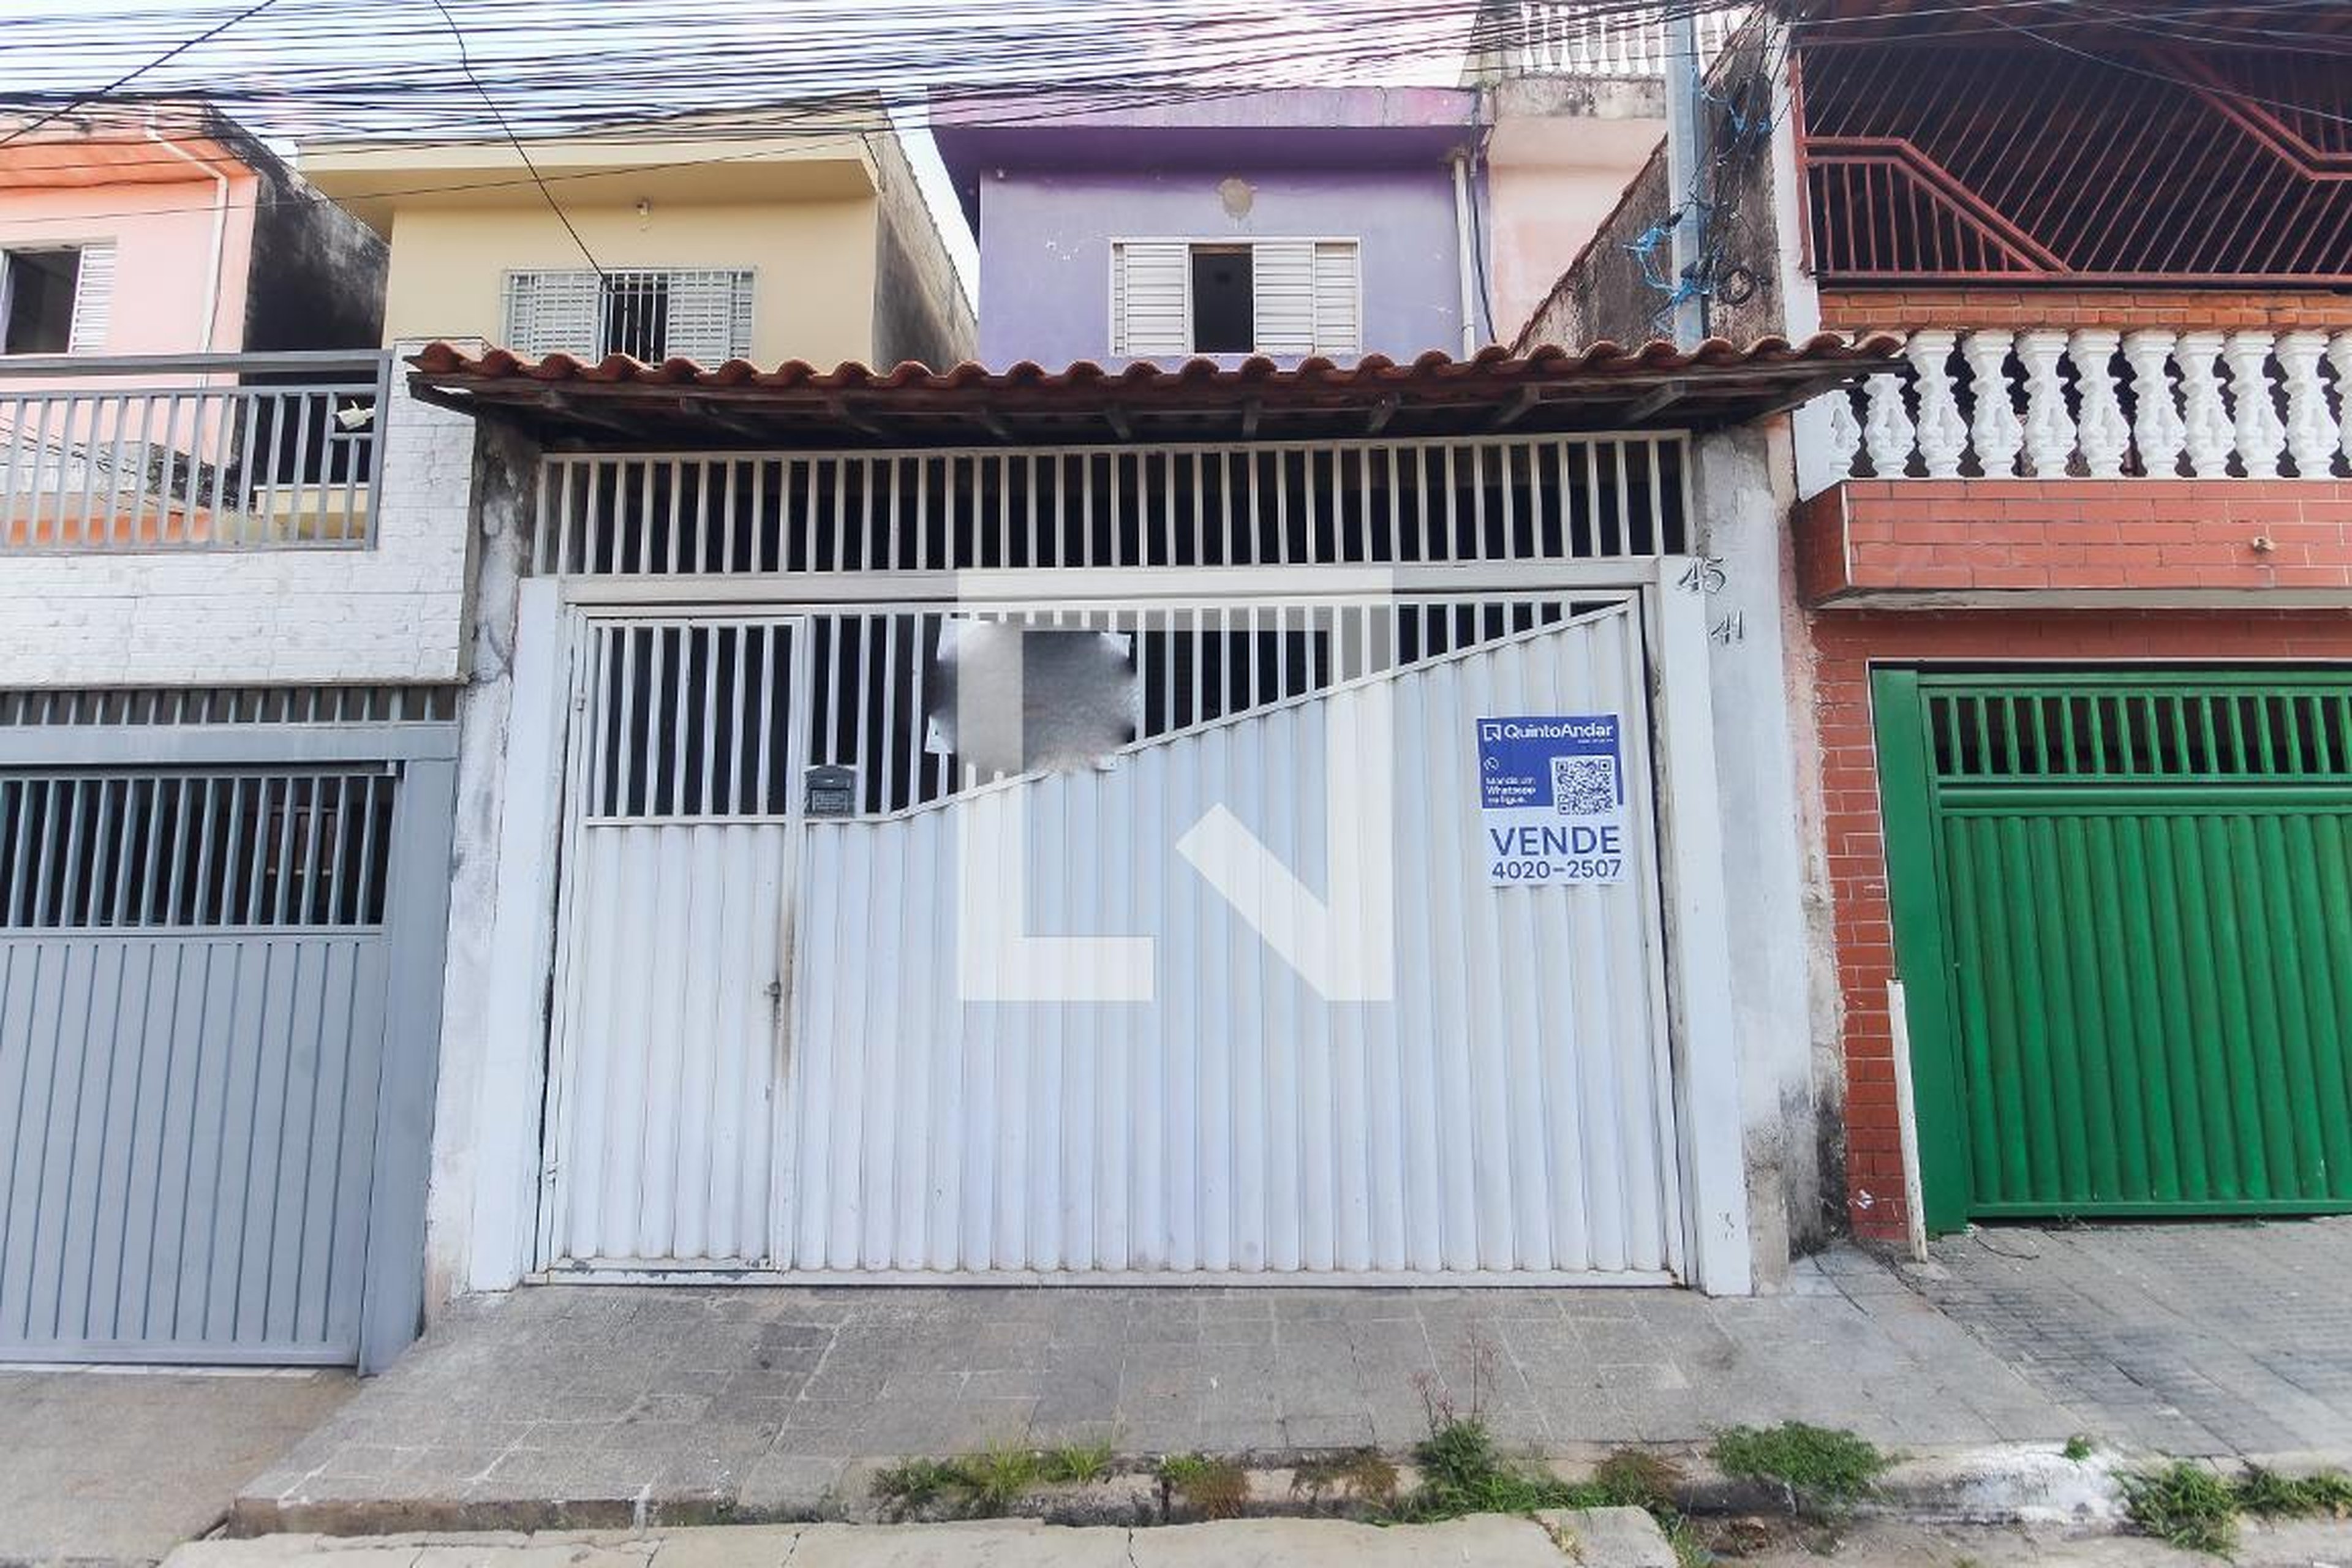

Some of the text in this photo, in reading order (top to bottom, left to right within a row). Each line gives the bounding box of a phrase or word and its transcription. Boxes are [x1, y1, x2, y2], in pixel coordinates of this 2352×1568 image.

[1678, 556, 1726, 594] 45
[1504, 723, 1614, 739] QuintoAndar
[1490, 826, 1621, 856] VENDE
[1491, 860, 1622, 879] 4020-2507
